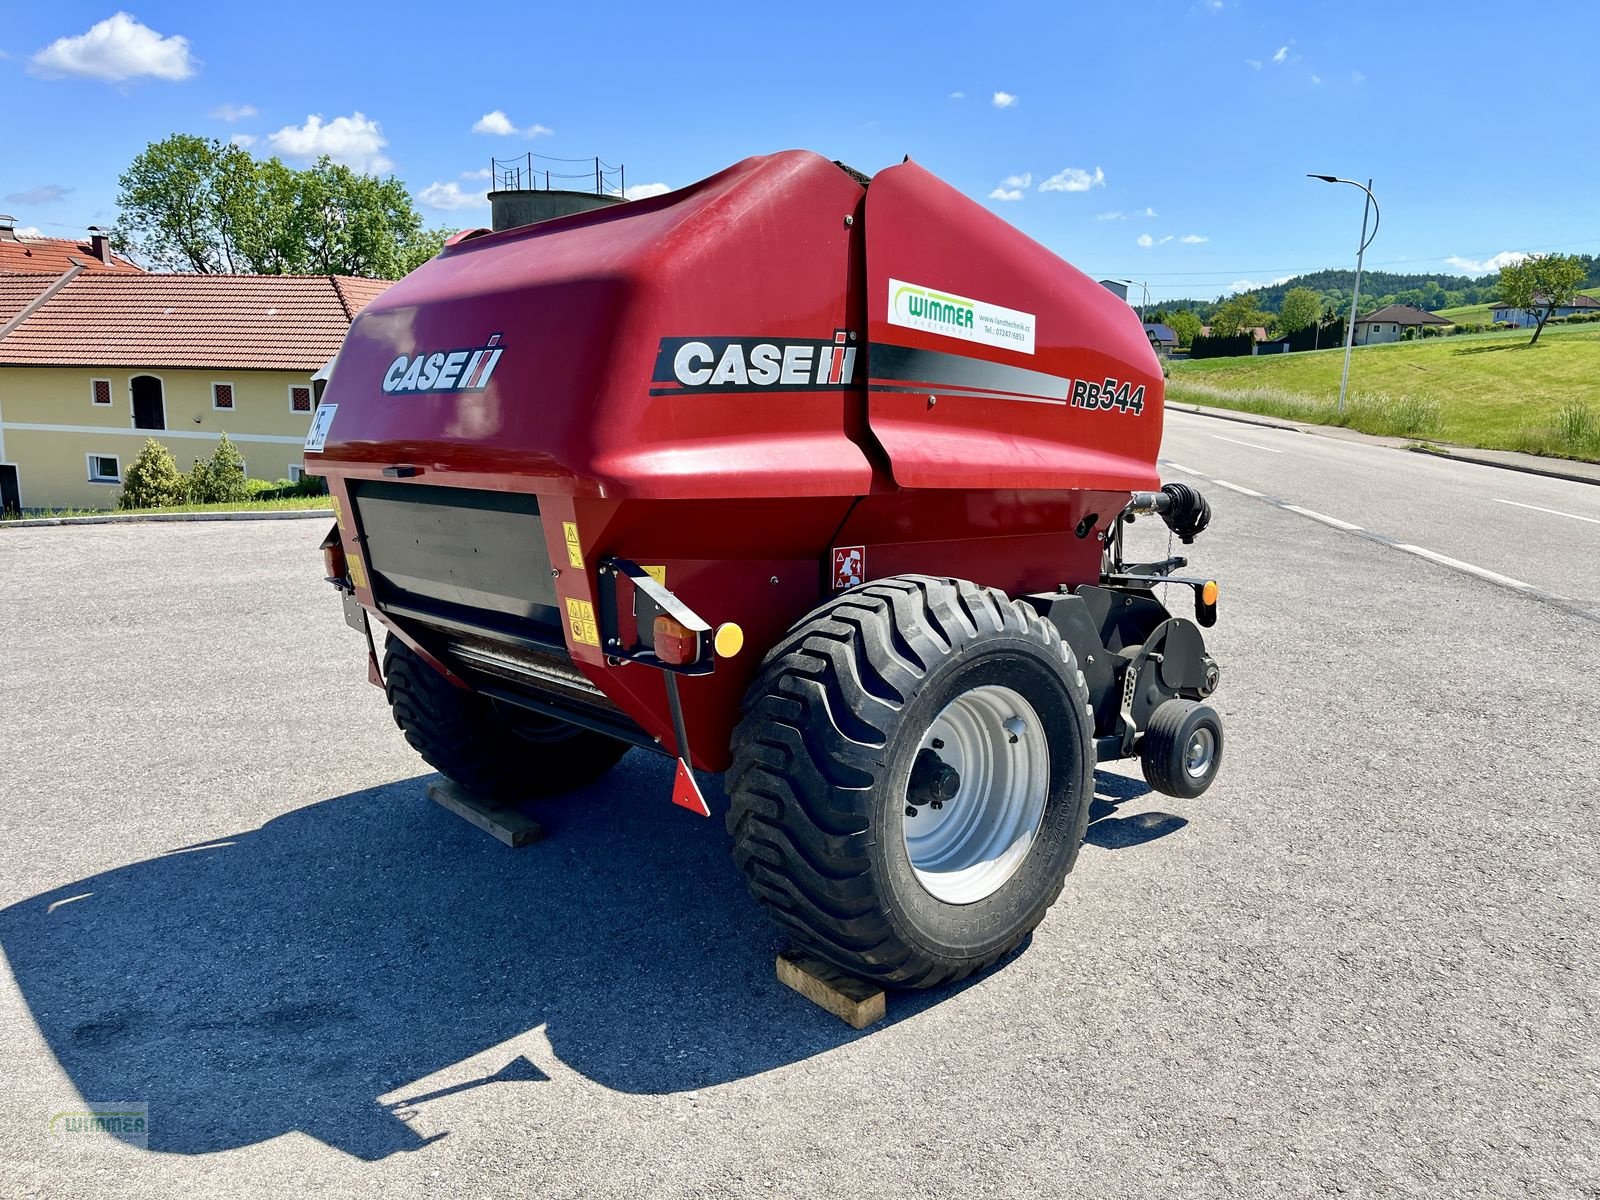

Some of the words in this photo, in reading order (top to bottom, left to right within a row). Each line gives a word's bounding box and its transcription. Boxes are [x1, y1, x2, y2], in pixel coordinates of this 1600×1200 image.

[909, 295, 974, 330] WIMMER
[978, 313, 1031, 333] www.landtechnik.cc
[995, 327, 1025, 342] 07247/6853
[383, 351, 469, 393] CASE
[673, 341, 815, 386] CASE
[1070, 377, 1146, 417] RB544
